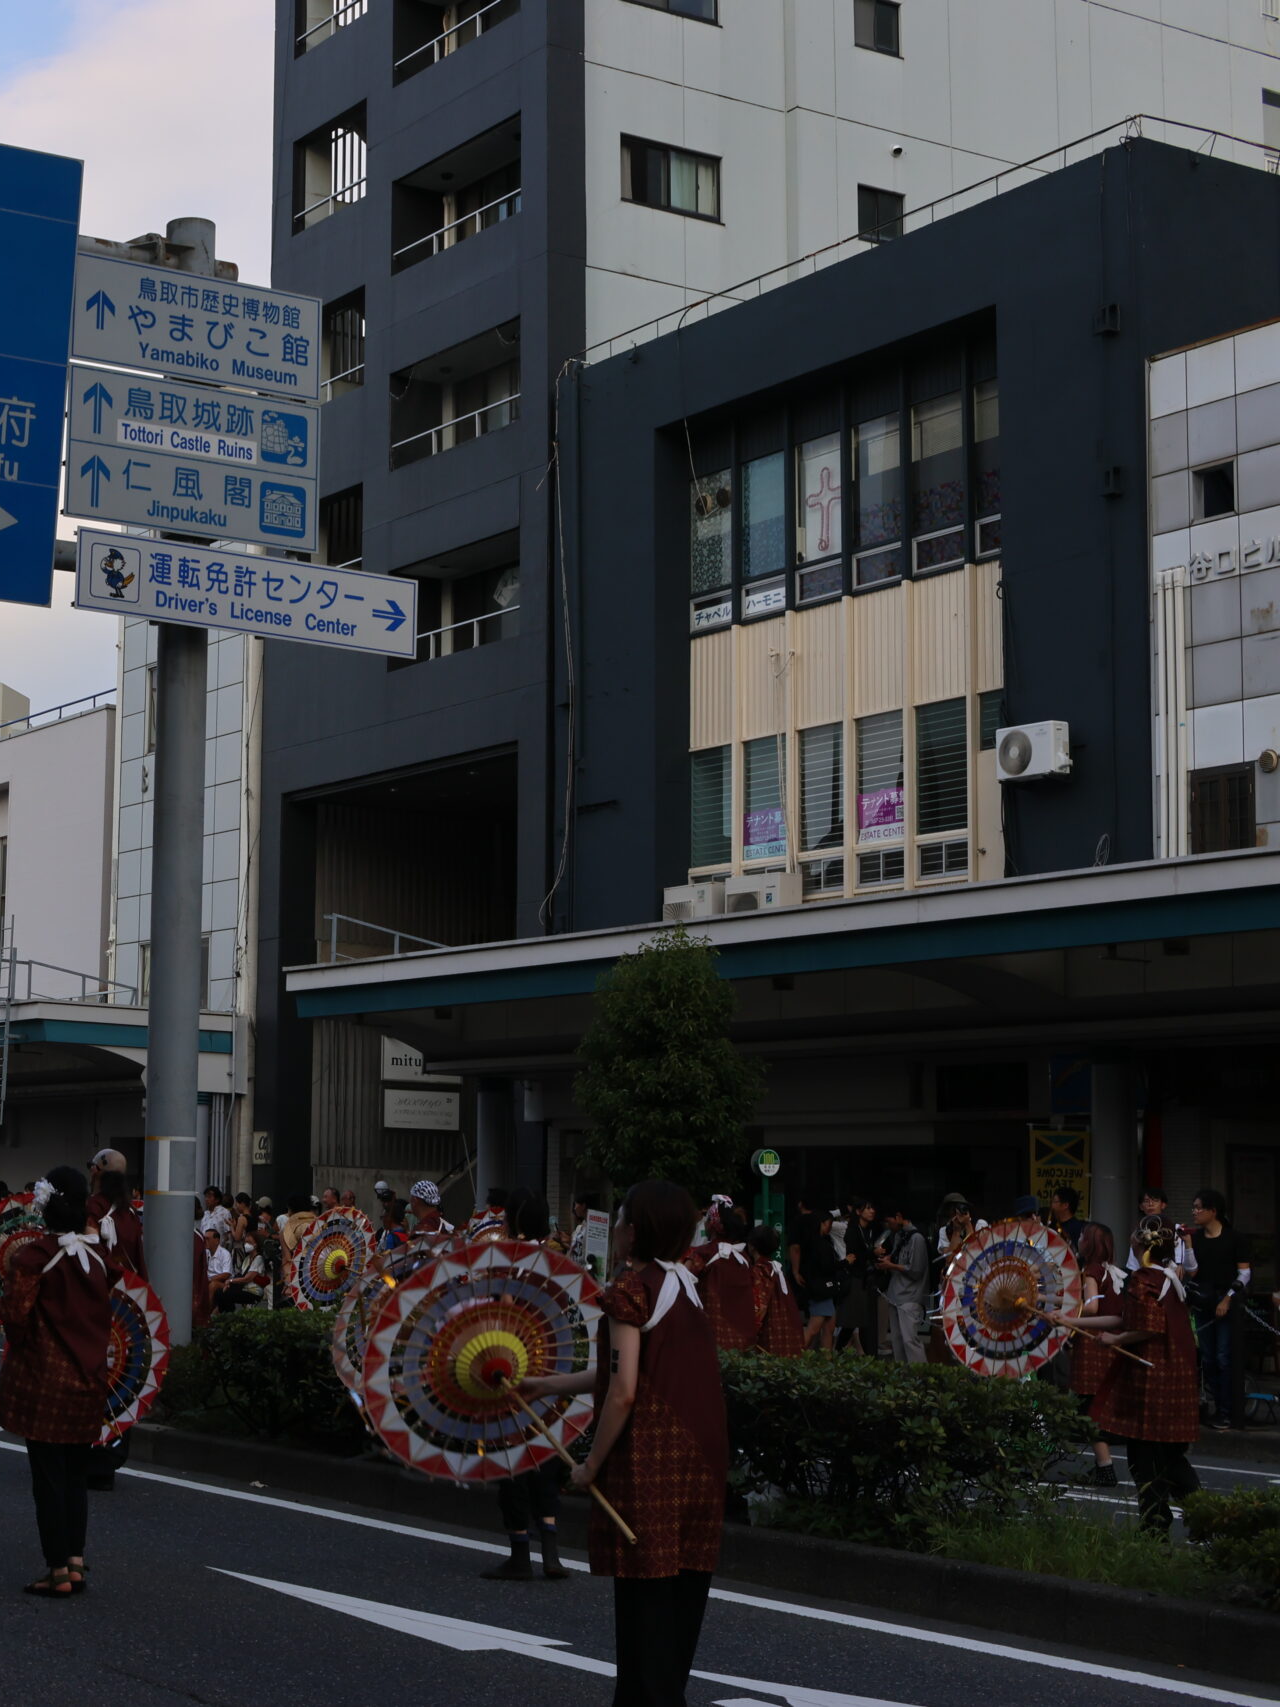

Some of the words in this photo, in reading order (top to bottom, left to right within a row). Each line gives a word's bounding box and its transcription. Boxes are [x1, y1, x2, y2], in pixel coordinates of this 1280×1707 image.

[137, 277, 302, 330] 鳥取市歴史博物館
[128, 305, 310, 367] やまびこ館
[139, 342, 220, 372] Yamabiko
[232, 359, 299, 387] Museum
[124, 387, 255, 437] 鳥取城跡
[121, 422, 164, 447] Tottori
[170, 430, 211, 454] Castle
[217, 439, 253, 461] Ruins
[122, 458, 252, 509] 仁風閣
[147, 500, 227, 528] Jinpukaku
[148, 552, 365, 609] 運転免許センター
[155, 590, 218, 617] Driver's
[230, 603, 293, 629] License
[305, 613, 357, 638] Center
[695, 606, 731, 626] チャペル
[746, 592, 786, 610] ハーモニ
